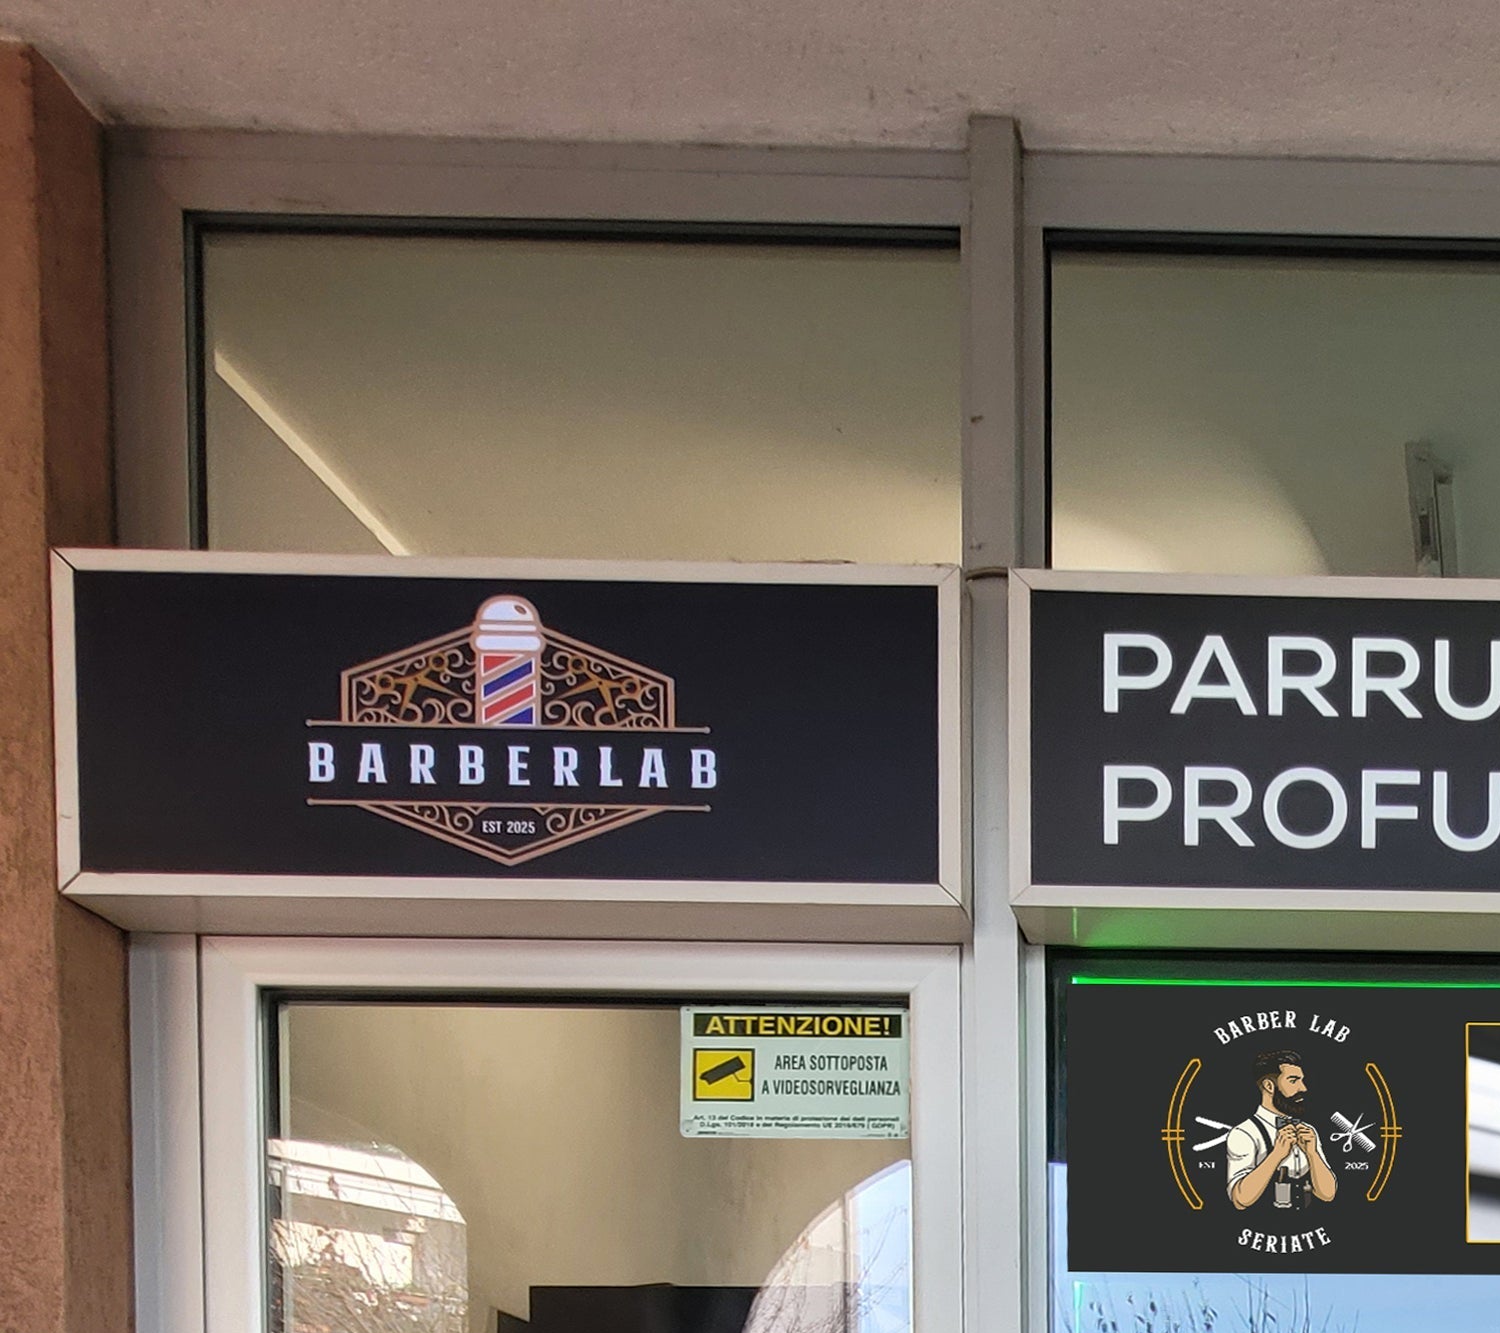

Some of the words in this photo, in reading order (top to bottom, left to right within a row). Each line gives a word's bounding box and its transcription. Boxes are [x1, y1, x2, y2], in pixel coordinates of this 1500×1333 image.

[481, 820, 503, 834] EST
[505, 820, 537, 835] 2025
[705, 1015, 891, 1036] ATTENZIONE!
[1212, 1010, 1297, 1045] BARBER
[1308, 1014, 1351, 1044] LAB
[774, 1055, 806, 1071] AREA
[809, 1055, 888, 1072] SOTTOPOSTA
[761, 1080, 769, 1095] A
[772, 1080, 901, 1096] VIDEOSORVEGLIANZA
[1237, 1227, 1332, 1254] SERIATE
